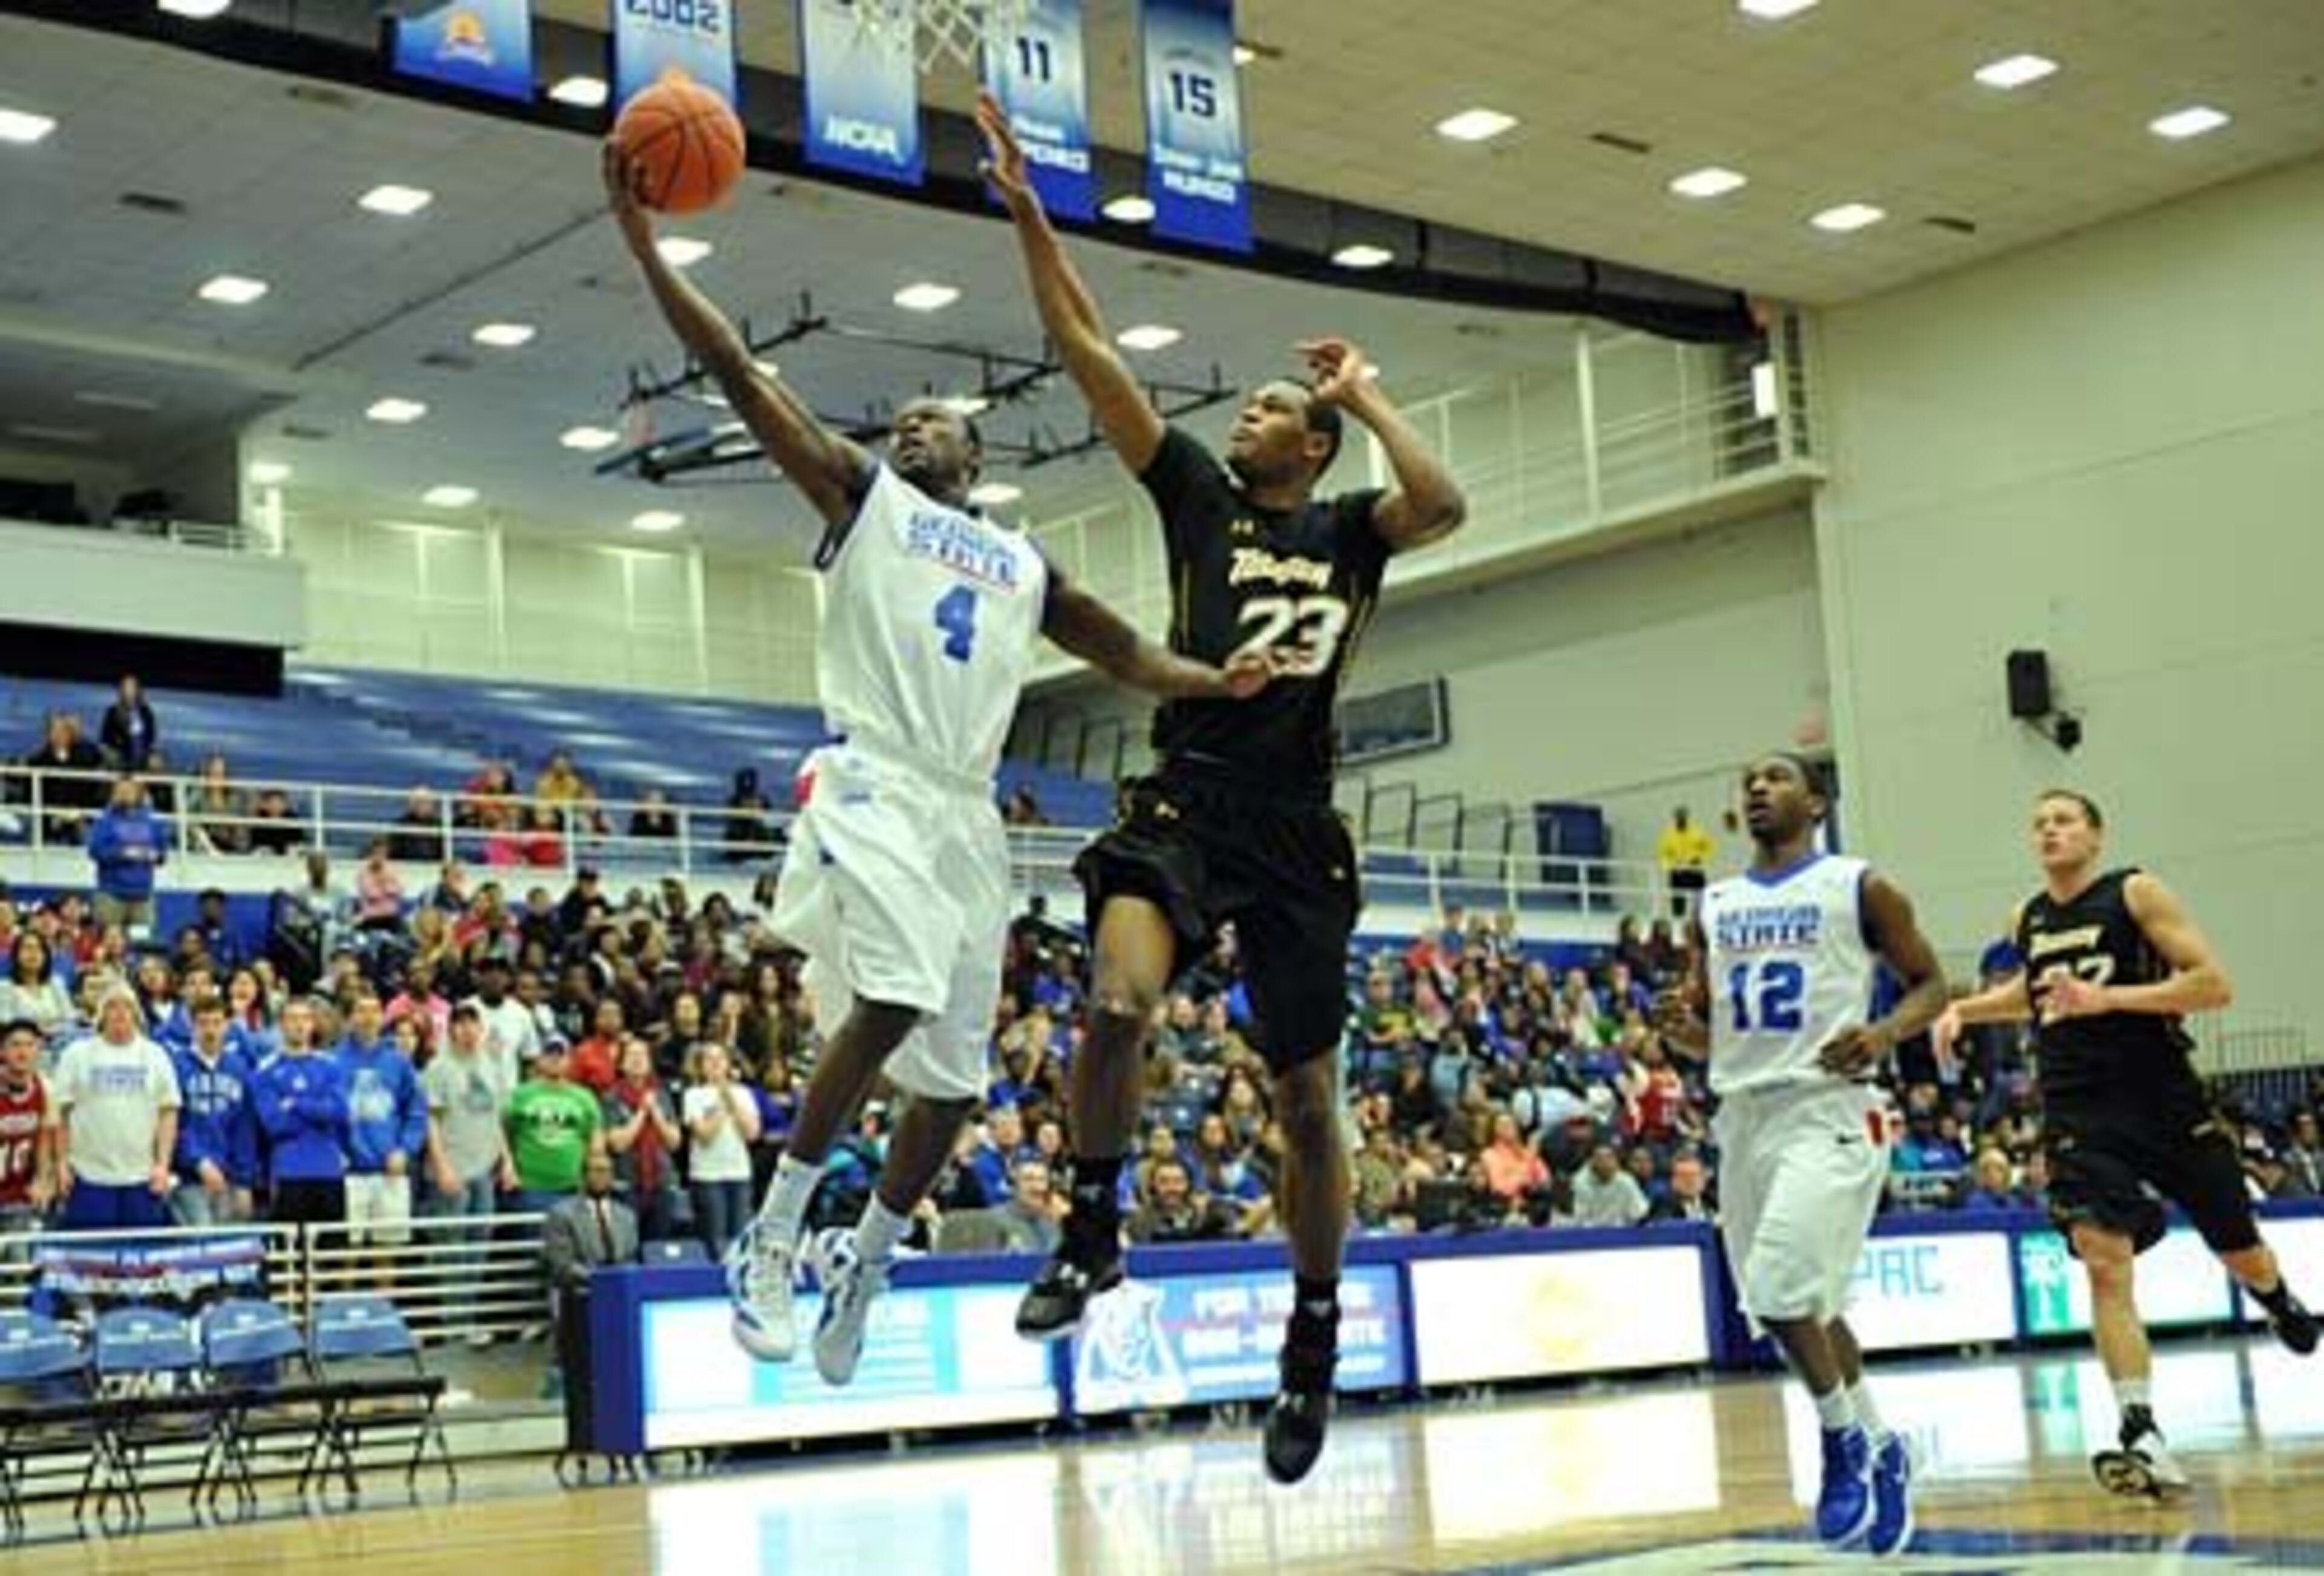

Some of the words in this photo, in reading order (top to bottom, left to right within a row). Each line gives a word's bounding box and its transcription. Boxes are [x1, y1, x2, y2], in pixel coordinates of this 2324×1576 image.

[1017, 36, 1050, 83] 11
[1169, 70, 1216, 119] 15
[934, 585, 977, 661] 4
[1224, 596, 1348, 677] 23
[1729, 960, 1804, 1031] 12
